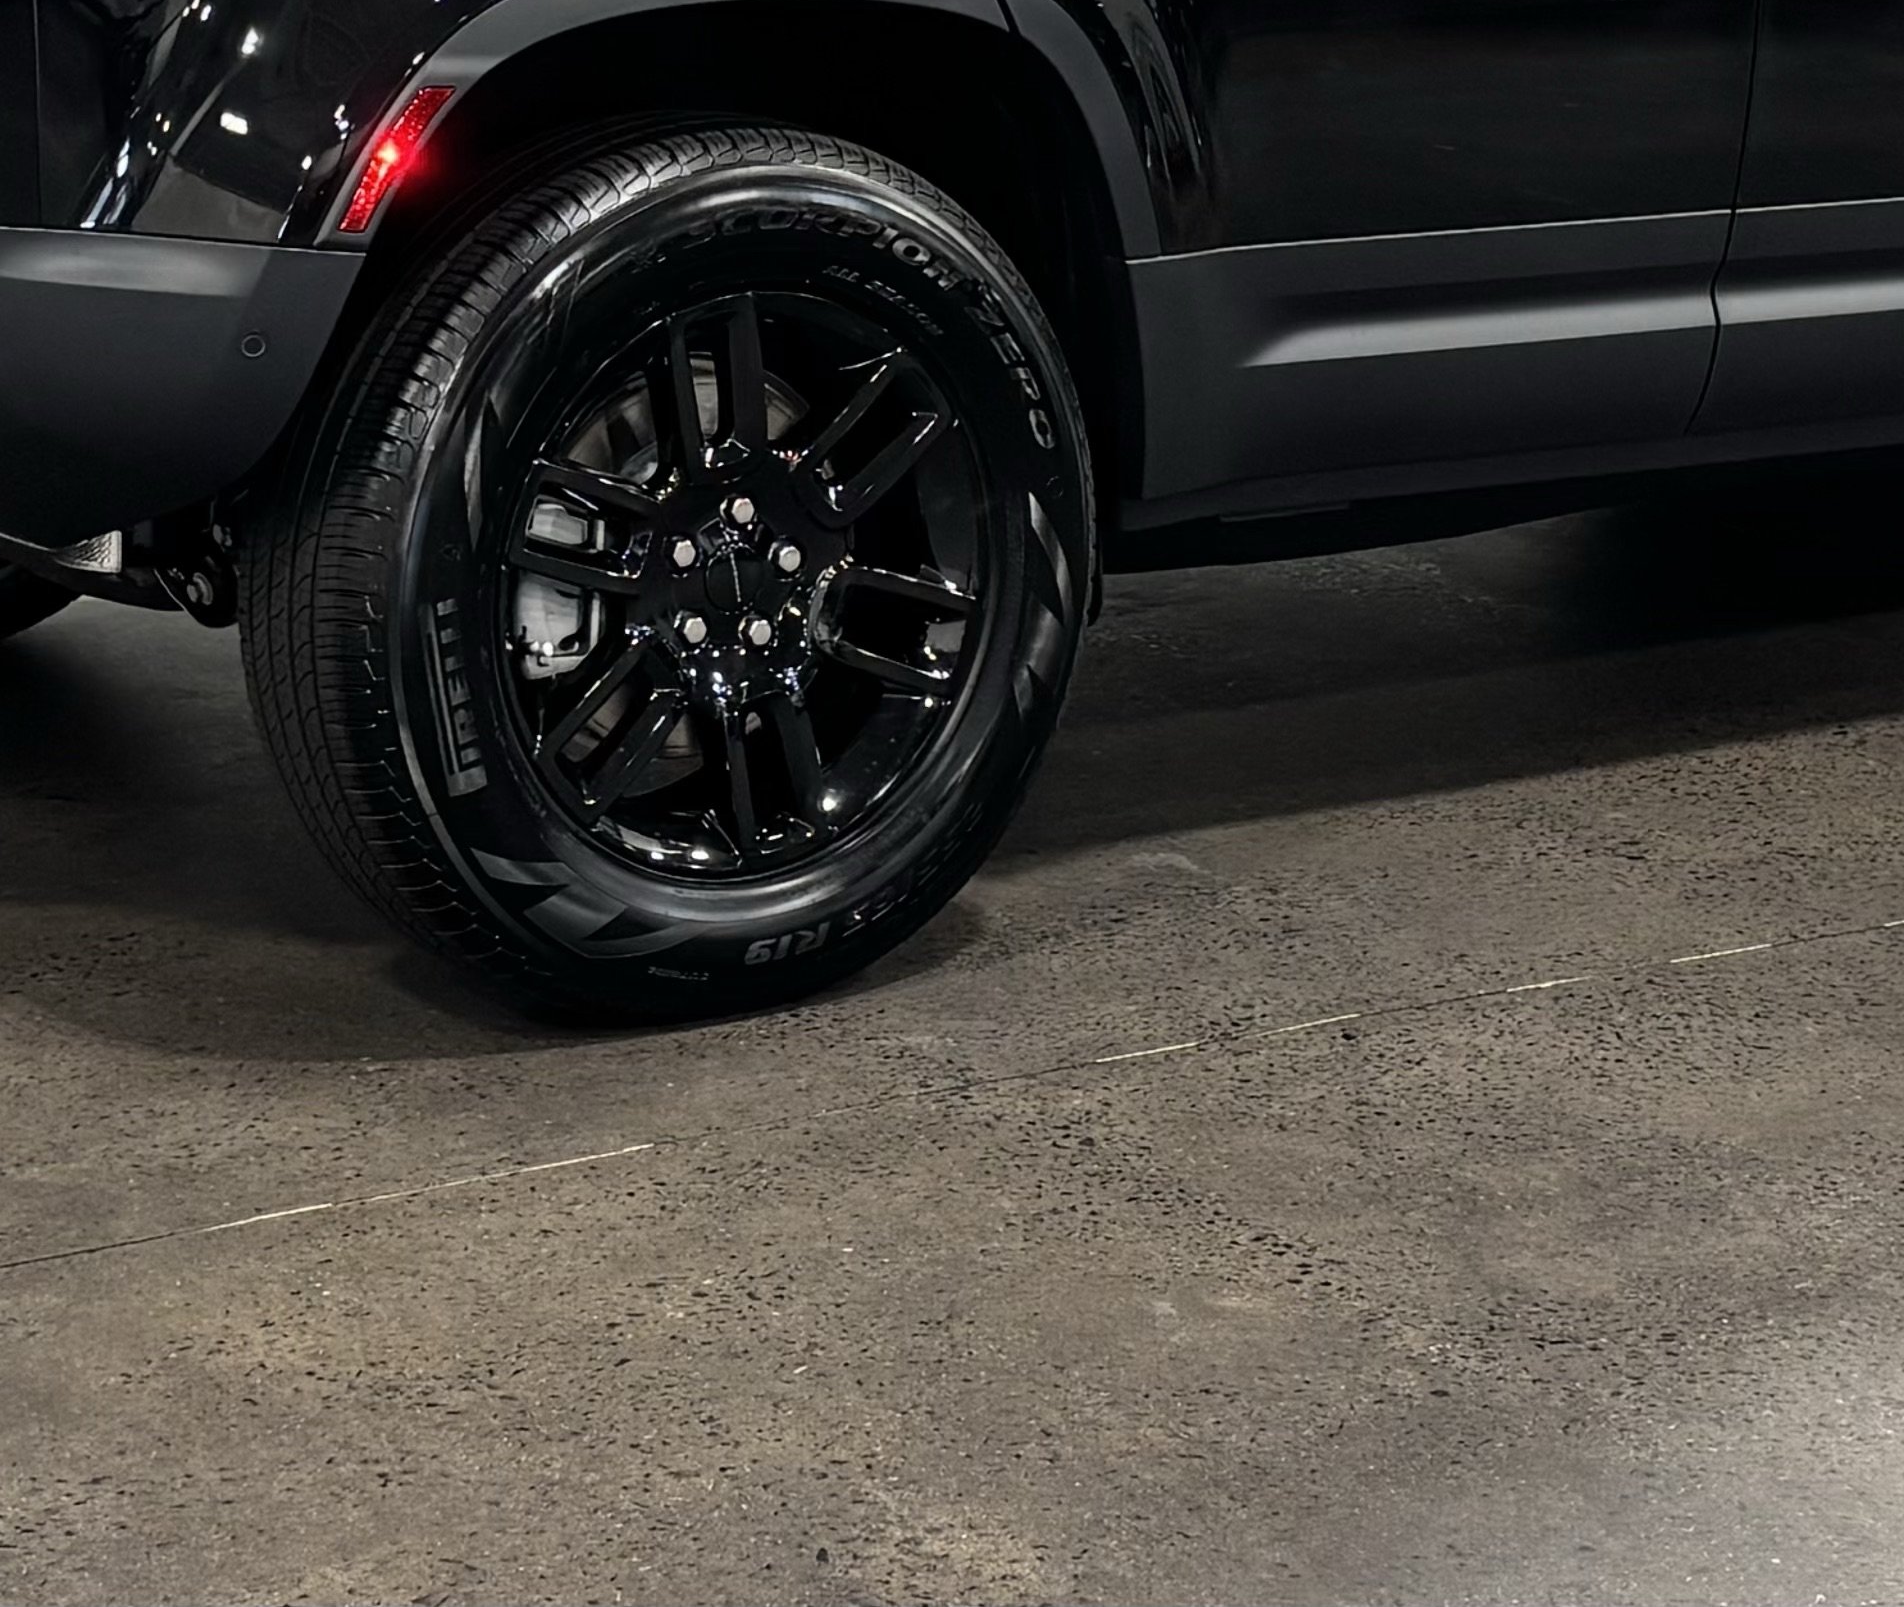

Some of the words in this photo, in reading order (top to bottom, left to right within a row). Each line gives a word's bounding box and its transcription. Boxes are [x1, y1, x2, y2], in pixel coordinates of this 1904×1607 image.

[964, 280, 1056, 450] ZERO
[421, 597, 488, 798] PIRELLI
[743, 921, 831, 967] R19
